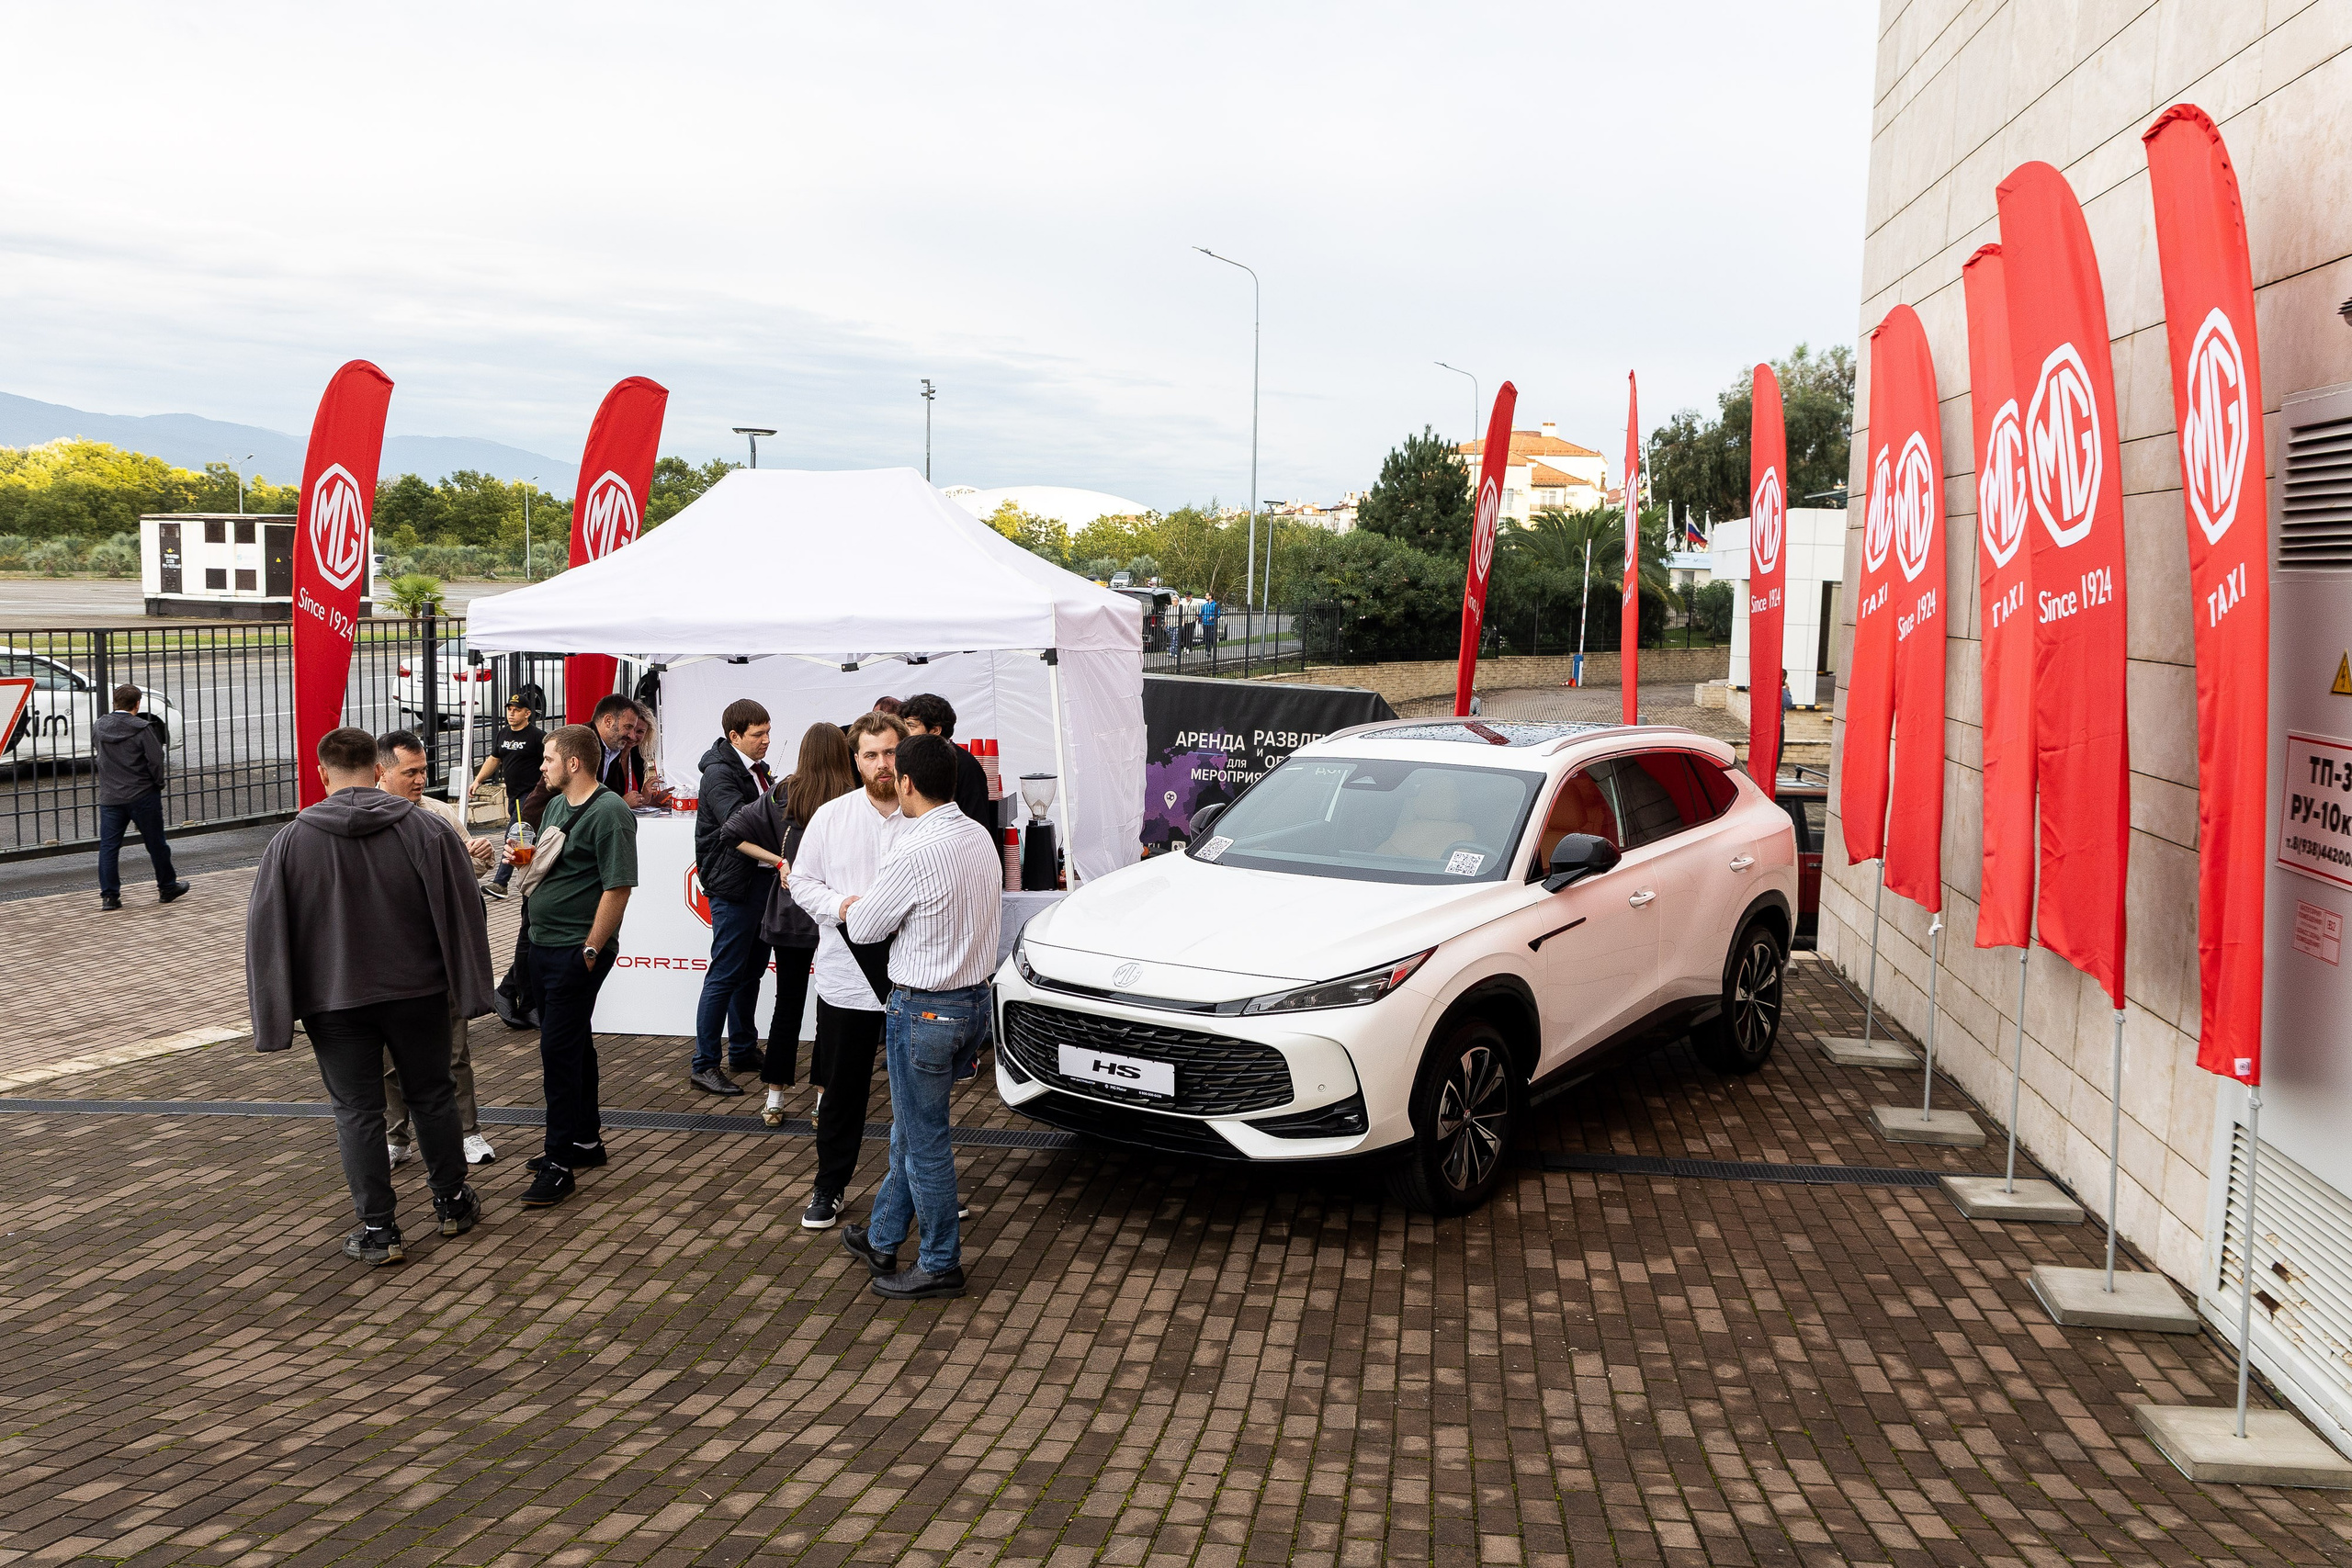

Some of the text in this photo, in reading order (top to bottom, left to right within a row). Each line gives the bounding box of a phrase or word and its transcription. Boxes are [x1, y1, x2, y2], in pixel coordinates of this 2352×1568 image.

[2034, 367, 2096, 522] MG
[2190, 334, 2242, 514] MG
[1868, 457, 1894, 557] MG
[1896, 448, 1929, 563] MG
[1985, 418, 2028, 547] MG
[316, 479, 360, 576] MG
[588, 483, 633, 560] MG
[1477, 489, 1496, 571] MG
[1756, 479, 1780, 561] MG
[298, 586, 356, 642] Since 1924
[1750, 586, 1781, 614] Since 1924
[1861, 581, 1889, 619] TAXI
[1897, 587, 1937, 642] Since 1924
[1992, 581, 2025, 628] TAXI
[2038, 565, 2113, 625] Since 1924
[2207, 562, 2246, 628] TAXI
[1175, 730, 1246, 753] АРЕНДА
[1227, 758, 1247, 769] ДЛЯ
[1256, 748, 1264, 758] И
[2310, 755, 2352, 793] ТП-3
[615, 955, 707, 971] ORRIS
[1114, 964, 1141, 986] MG
[1091, 1059, 1141, 1079] HS
